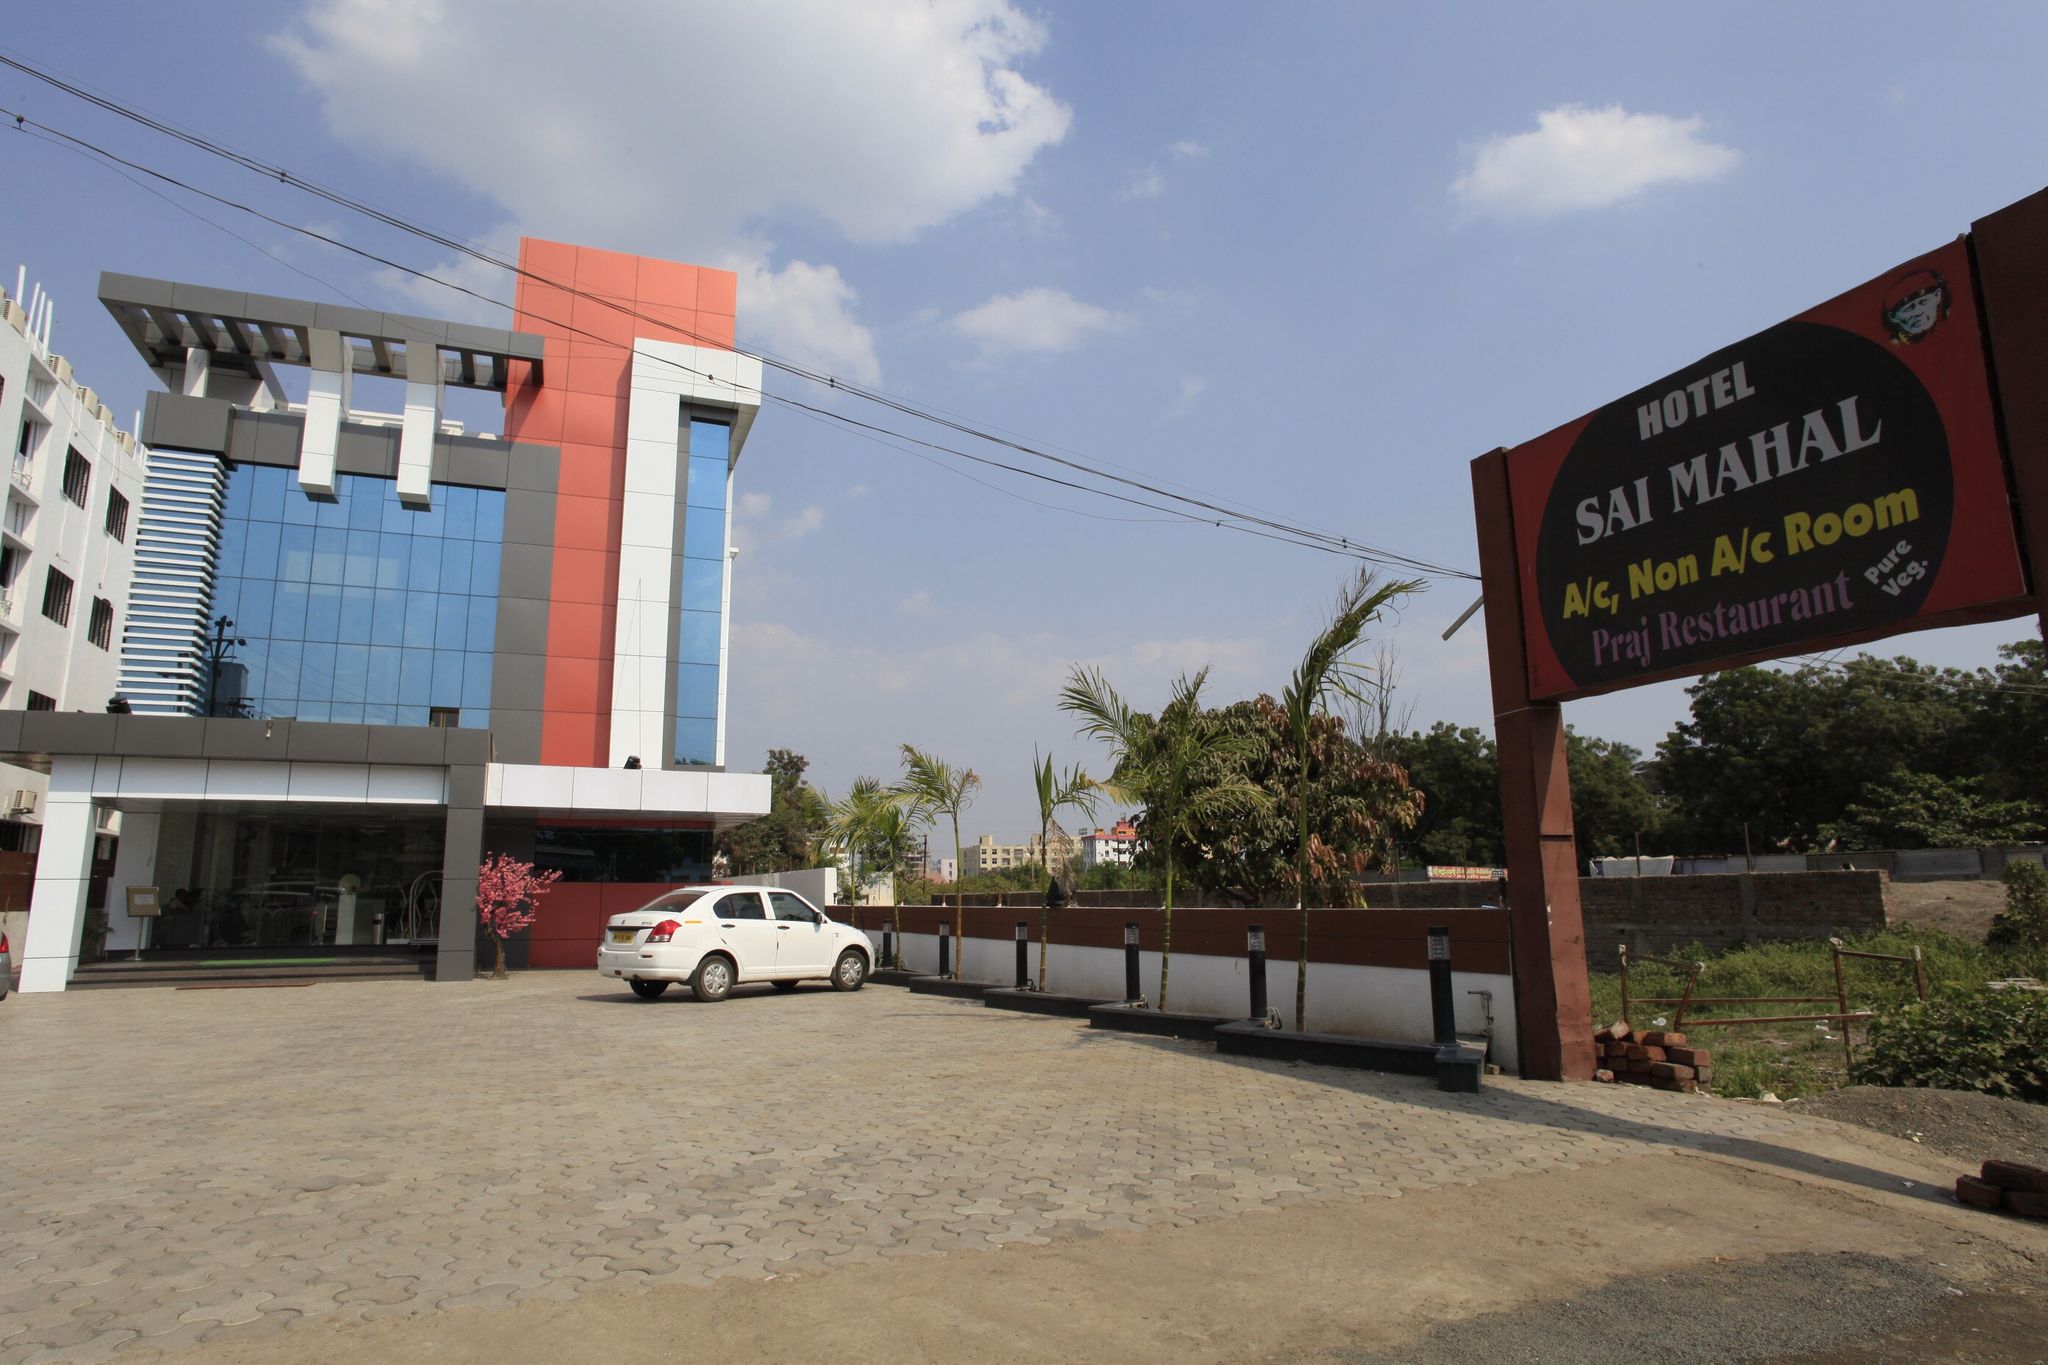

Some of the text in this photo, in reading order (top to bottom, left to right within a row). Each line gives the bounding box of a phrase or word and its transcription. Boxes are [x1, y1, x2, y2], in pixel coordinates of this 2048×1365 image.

[1637, 361, 1755, 441] HOTEL
[1576, 395, 1882, 546] SAI MAHAL
[1562, 487, 1920, 619] A/c, Non A/c Room
[1863, 540, 1912, 585] Pure
[1881, 560, 1928, 597] Veg.
[1592, 569, 1854, 668] Praj Restaurant
